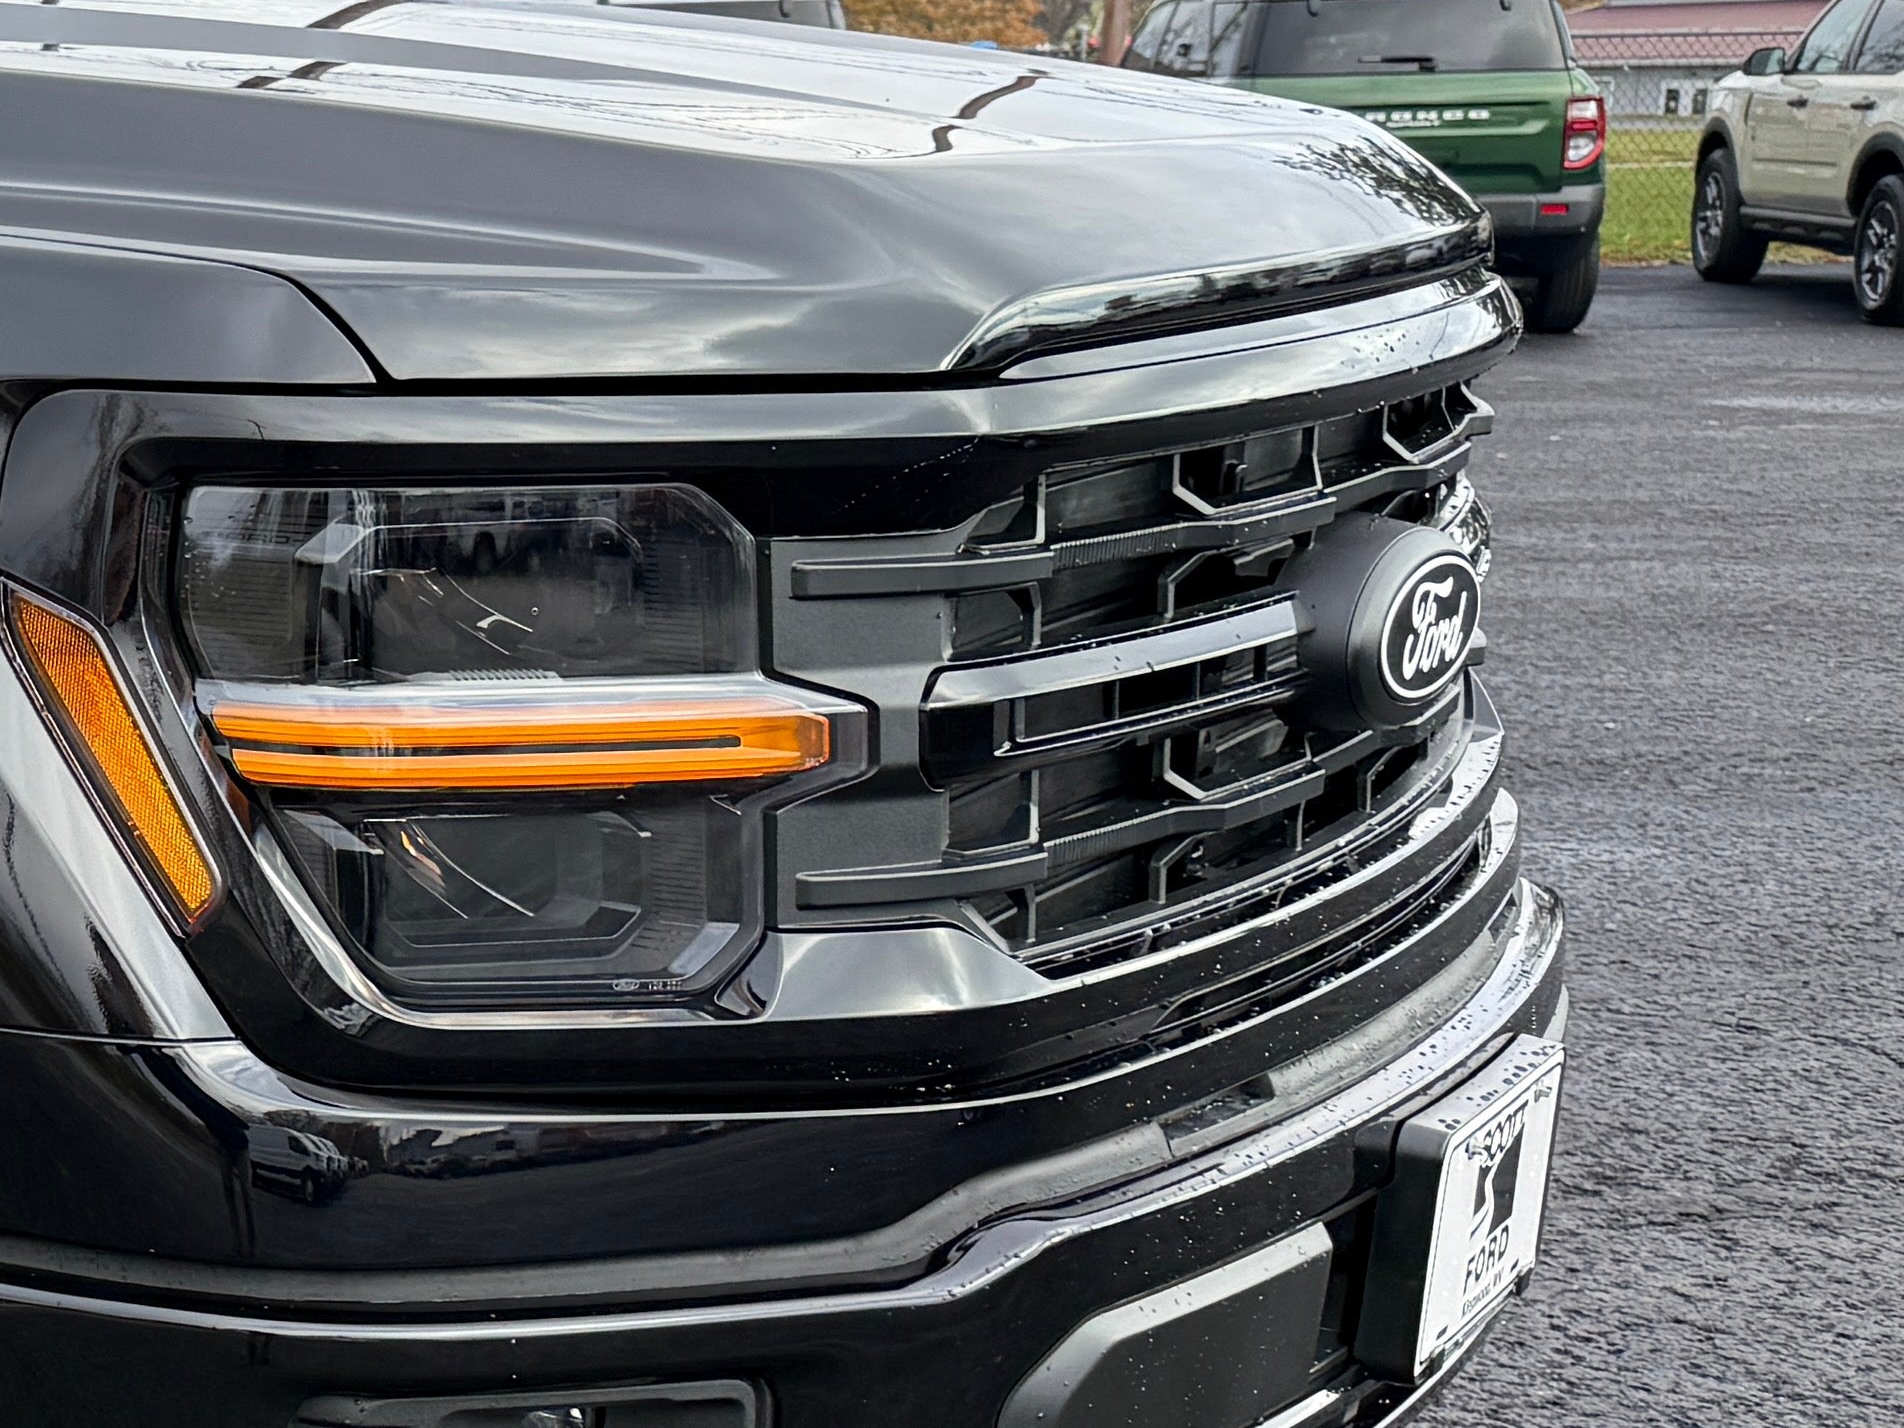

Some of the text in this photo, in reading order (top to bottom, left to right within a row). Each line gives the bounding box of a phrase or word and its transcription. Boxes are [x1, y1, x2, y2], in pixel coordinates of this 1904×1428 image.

[1365, 109, 1490, 122] RONCO
[1402, 576, 1468, 680] Ford
[1480, 1099, 1529, 1163] SCOTT
[1462, 1224, 1509, 1297] FORD
